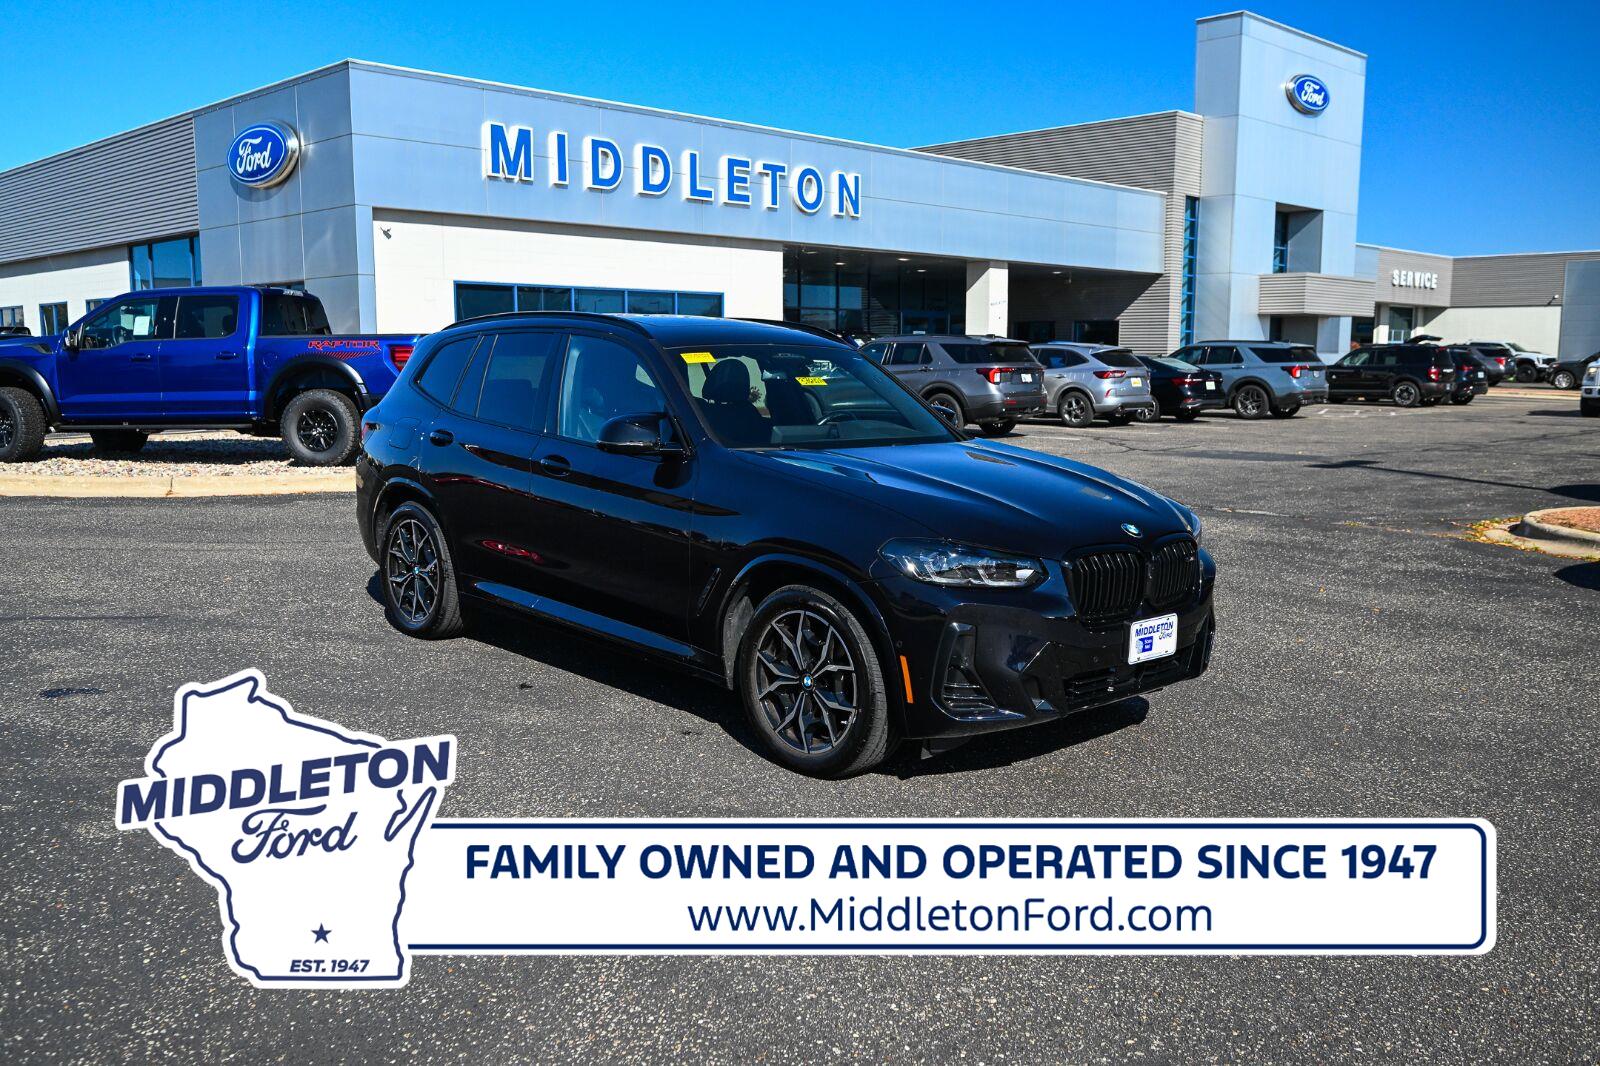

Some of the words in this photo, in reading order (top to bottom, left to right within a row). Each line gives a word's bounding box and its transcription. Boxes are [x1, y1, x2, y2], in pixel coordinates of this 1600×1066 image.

[1301, 81, 1325, 106] Ford
[236, 136, 272, 174] Ford
[483, 121, 862, 218] MIDDLETON
[1392, 269, 1438, 289] SERVICE
[308, 340, 381, 351] RAPTOR
[1135, 621, 1174, 637] MIDDLETON
